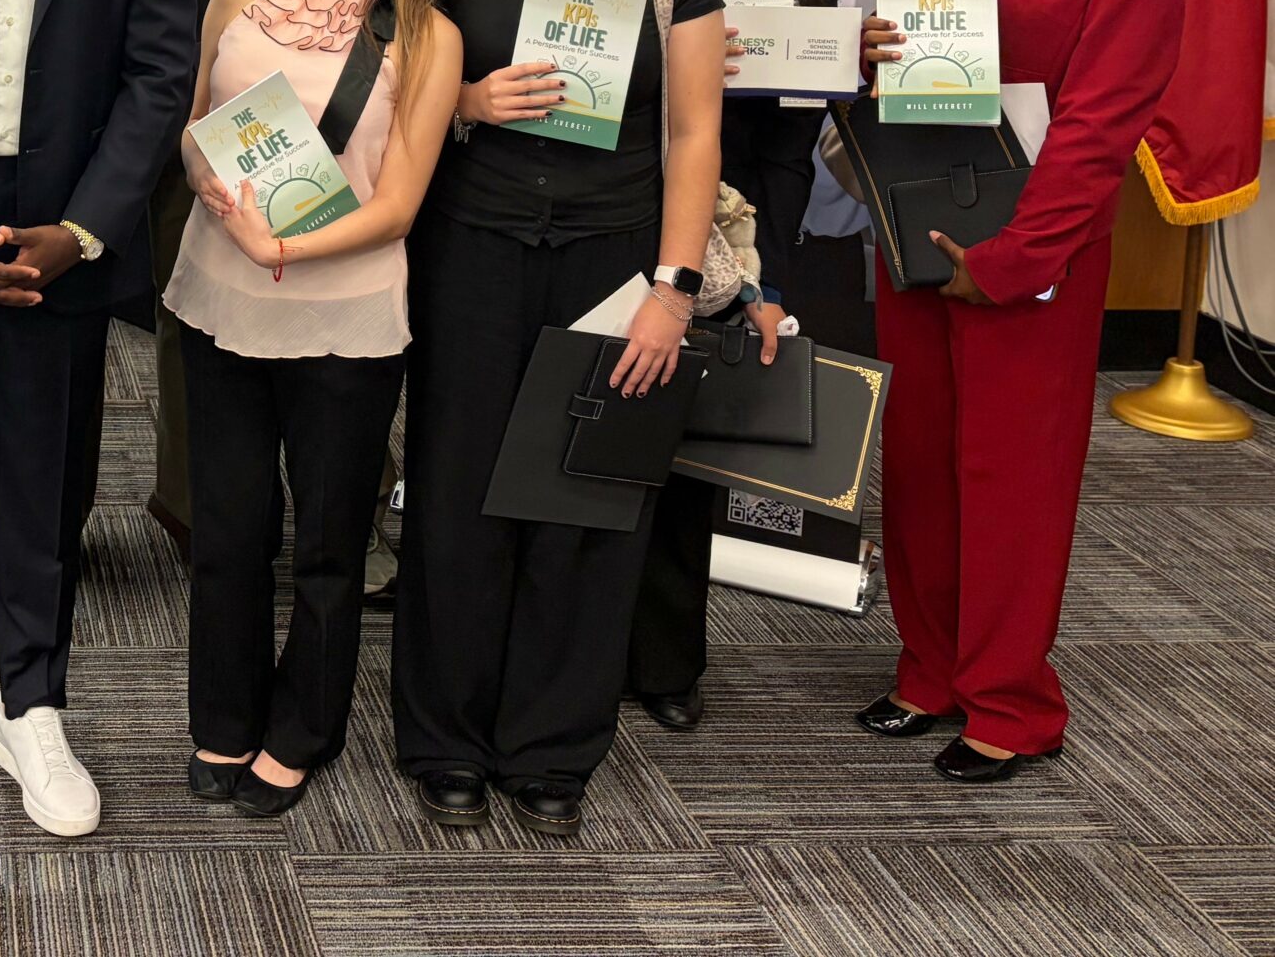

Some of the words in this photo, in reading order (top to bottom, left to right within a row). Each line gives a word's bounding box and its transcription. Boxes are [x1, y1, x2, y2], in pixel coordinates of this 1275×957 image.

[904, 11, 925, 31] OF
[930, 11, 967, 31] LIFE
[544, 20, 568, 42] OF
[569, 26, 608, 51] LIFE
[532, 40, 576, 54] Perspective
[577, 46, 588, 55] for
[589, 50, 620, 62] Success
[231, 107, 257, 129] THE
[553, 119, 592, 132] EVERETT
[236, 149, 258, 174] OF
[256, 128, 293, 161] LIFE
